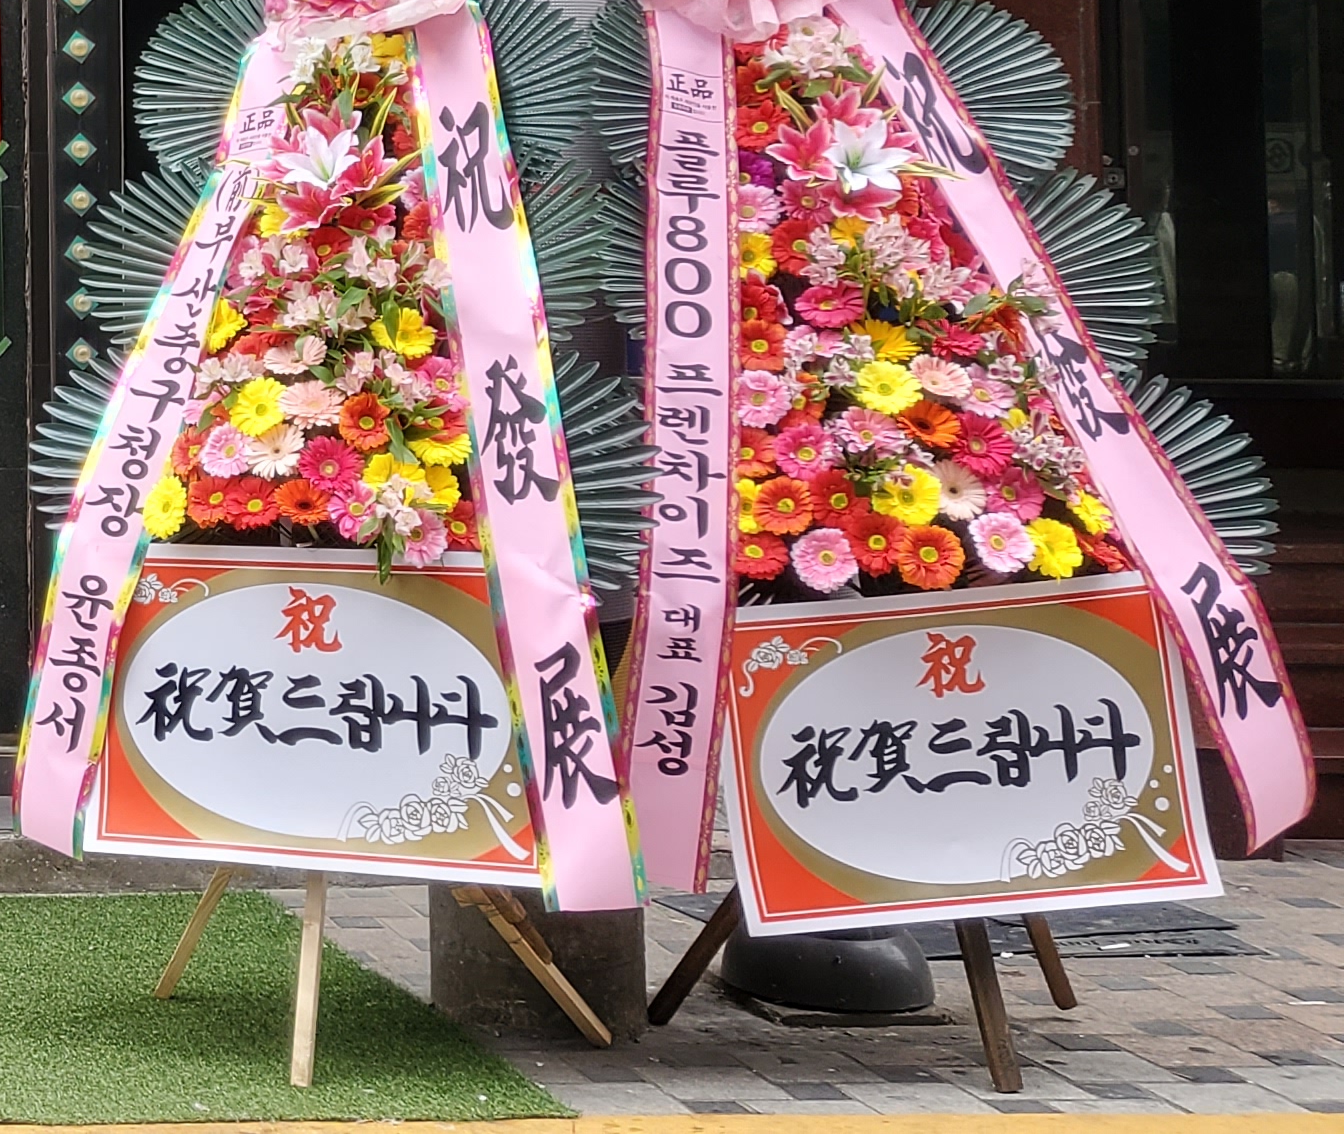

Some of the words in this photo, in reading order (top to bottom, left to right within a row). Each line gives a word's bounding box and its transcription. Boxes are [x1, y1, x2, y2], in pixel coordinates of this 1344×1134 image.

[666, 73, 714, 100] 正品
[238, 109, 275, 134] 正品
[655, 363, 727, 584] 프렌차이즈
[273, 585, 343, 654] 祝
[657, 603, 703, 663] 대표
[35, 574, 114, 753] 윤종서
[915, 631, 987, 699] 祝
[635, 681, 699, 776] 김성
